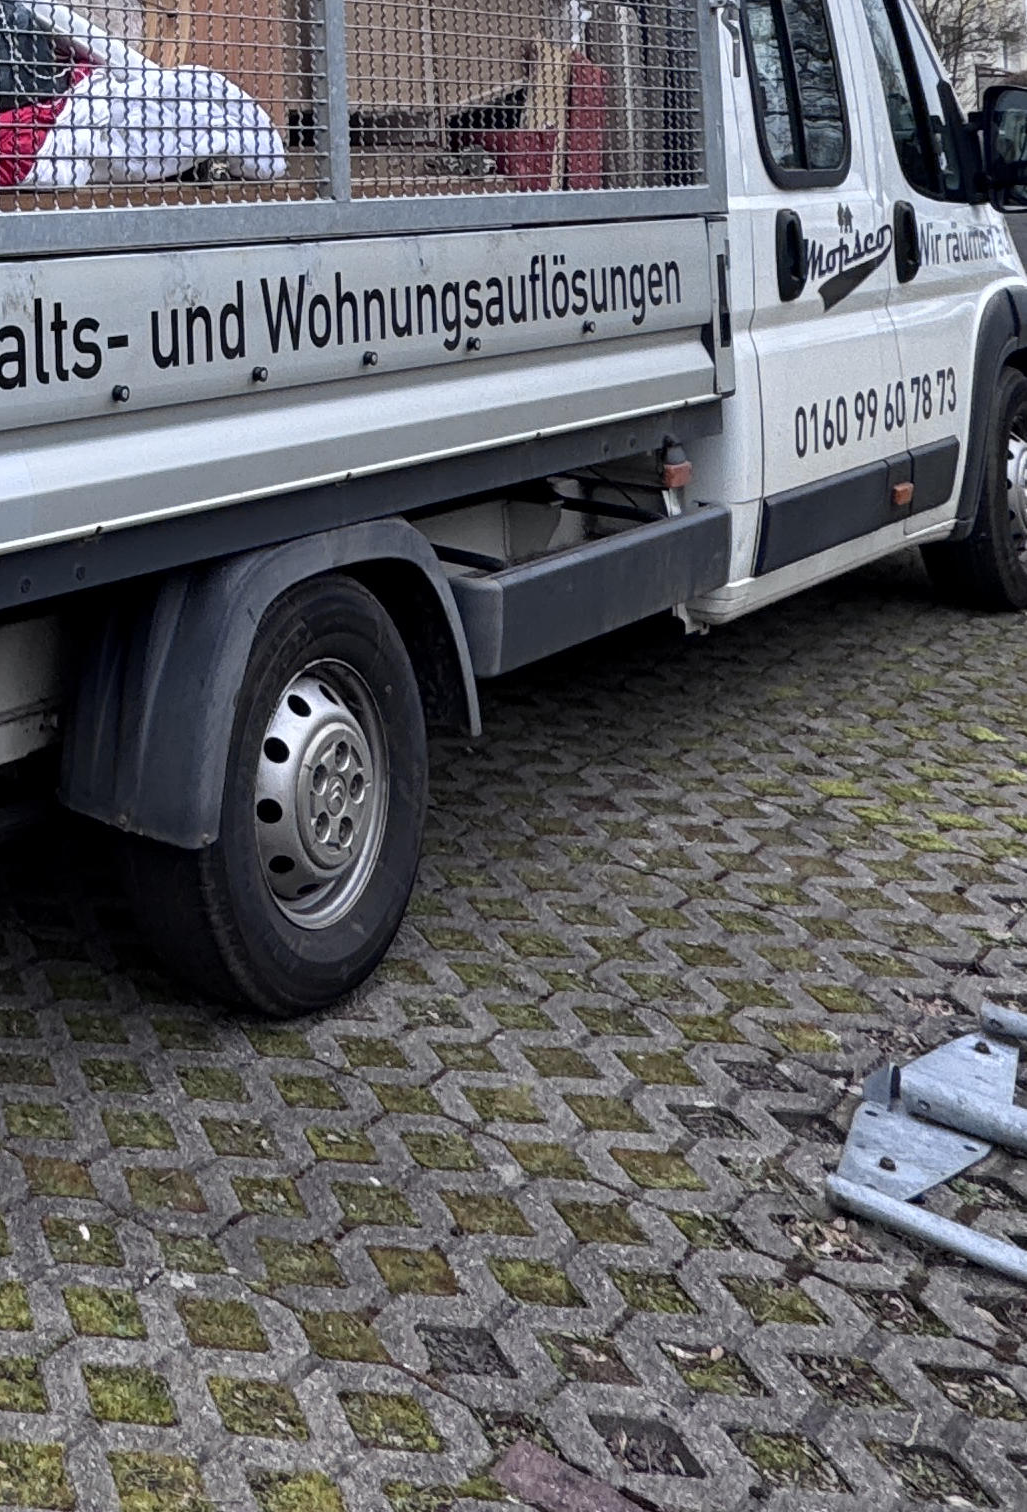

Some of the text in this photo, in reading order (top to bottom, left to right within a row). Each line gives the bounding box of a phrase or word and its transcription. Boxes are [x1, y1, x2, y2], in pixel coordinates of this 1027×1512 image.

[917, 221, 942, 267] Wir
[151, 280, 247, 369] und
[261, 254, 682, 352] Wohnungsauflösungen
[794, 367, 957, 459] 0160 99 60 78 73
